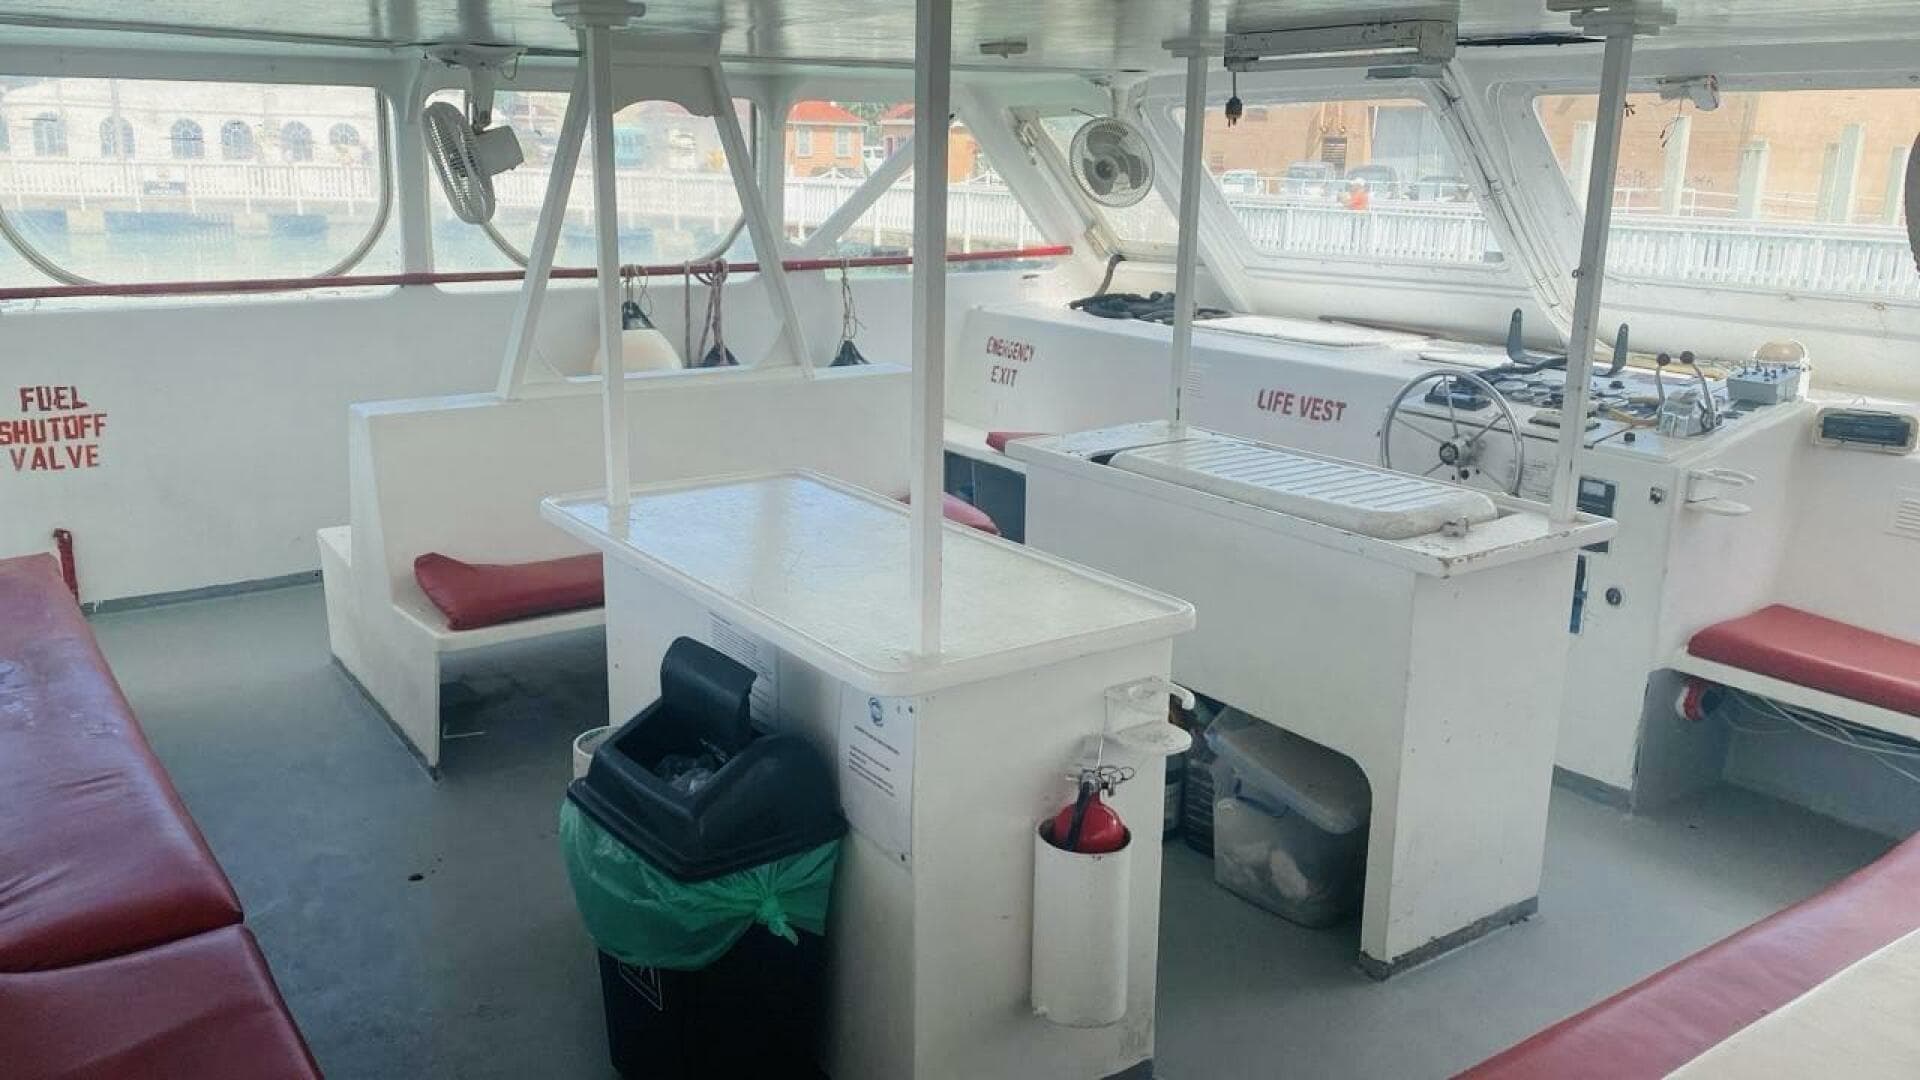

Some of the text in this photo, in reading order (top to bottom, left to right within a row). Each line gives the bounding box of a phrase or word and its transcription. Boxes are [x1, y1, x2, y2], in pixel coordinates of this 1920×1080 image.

[991, 366, 1018, 387] EXIT
[20, 386, 89, 412] FUEL
[1257, 389, 1348, 420] LIFE VEST
[0, 414, 108, 445] SHUTOFF
[10, 445, 100, 471] VALVE
